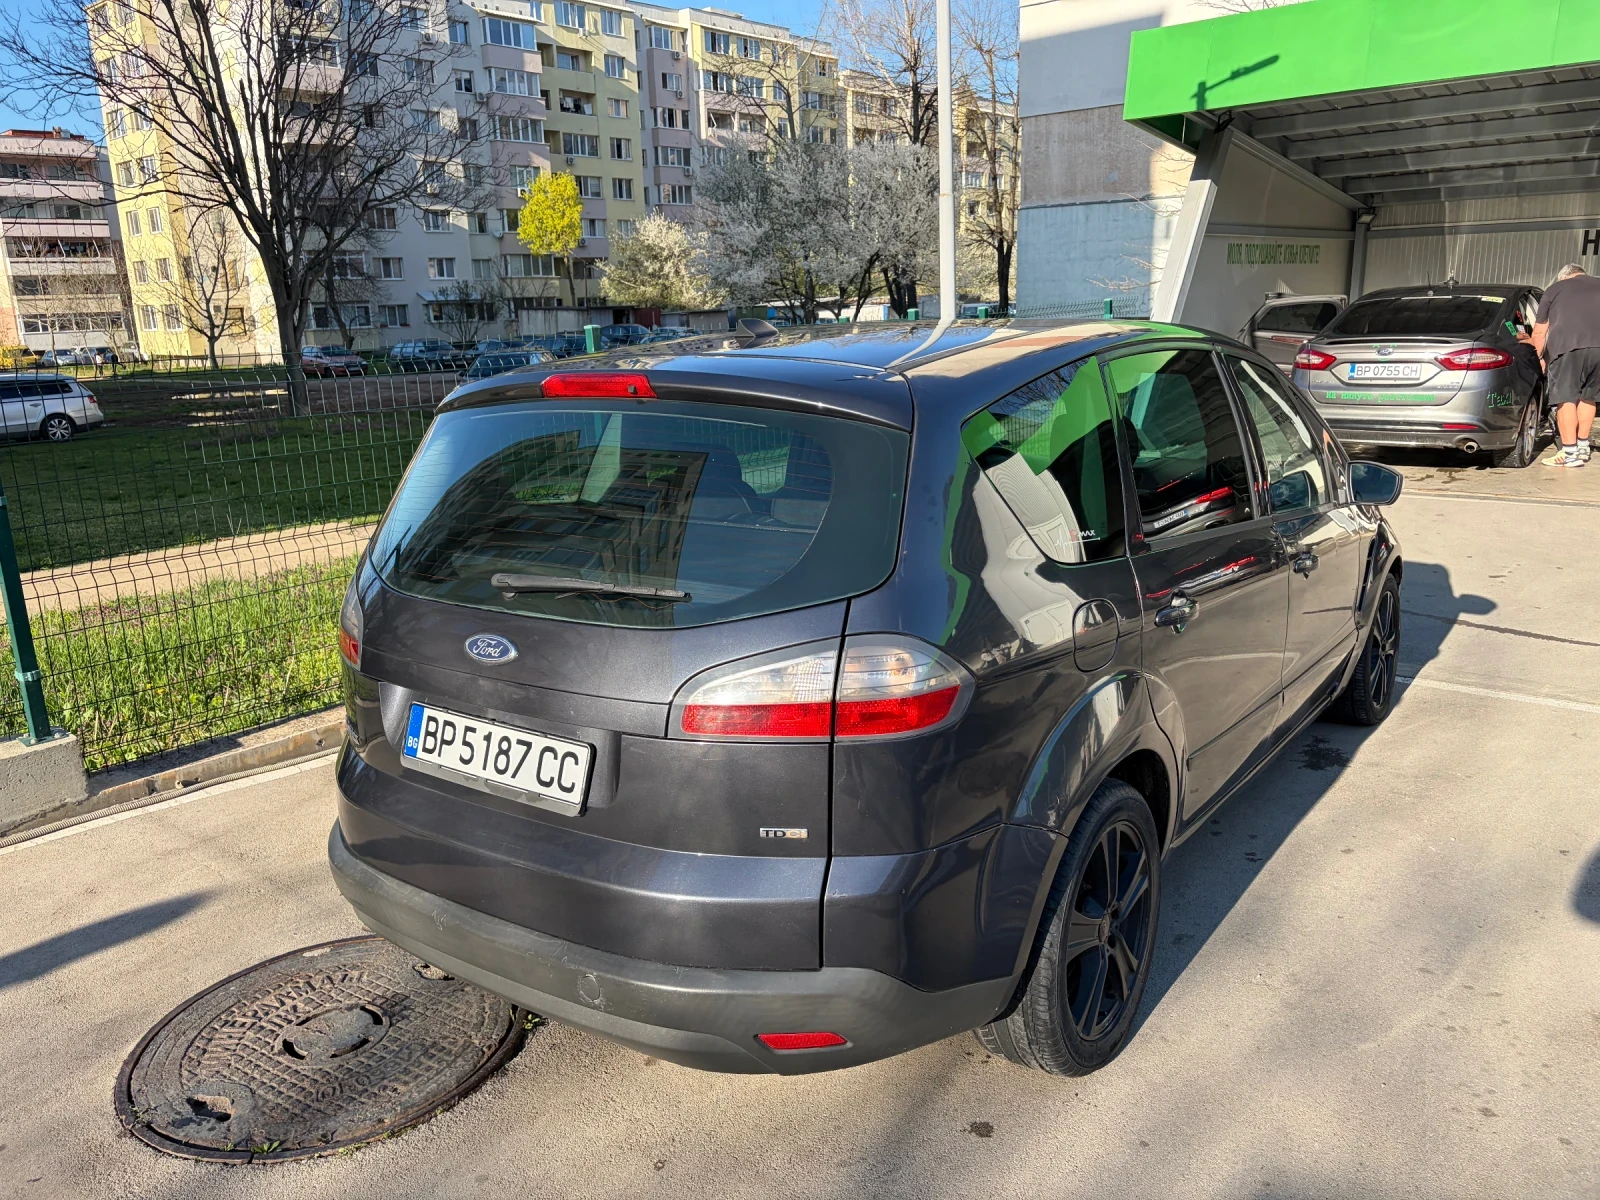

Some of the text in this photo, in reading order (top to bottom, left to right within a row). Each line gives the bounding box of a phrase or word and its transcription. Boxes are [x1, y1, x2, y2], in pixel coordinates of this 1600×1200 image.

[1356, 365, 1418, 376] BP 0755 CH
[472, 638, 504, 657] Ford
[407, 735, 418, 748] BG
[421, 715, 579, 794] BP 5187 CC
